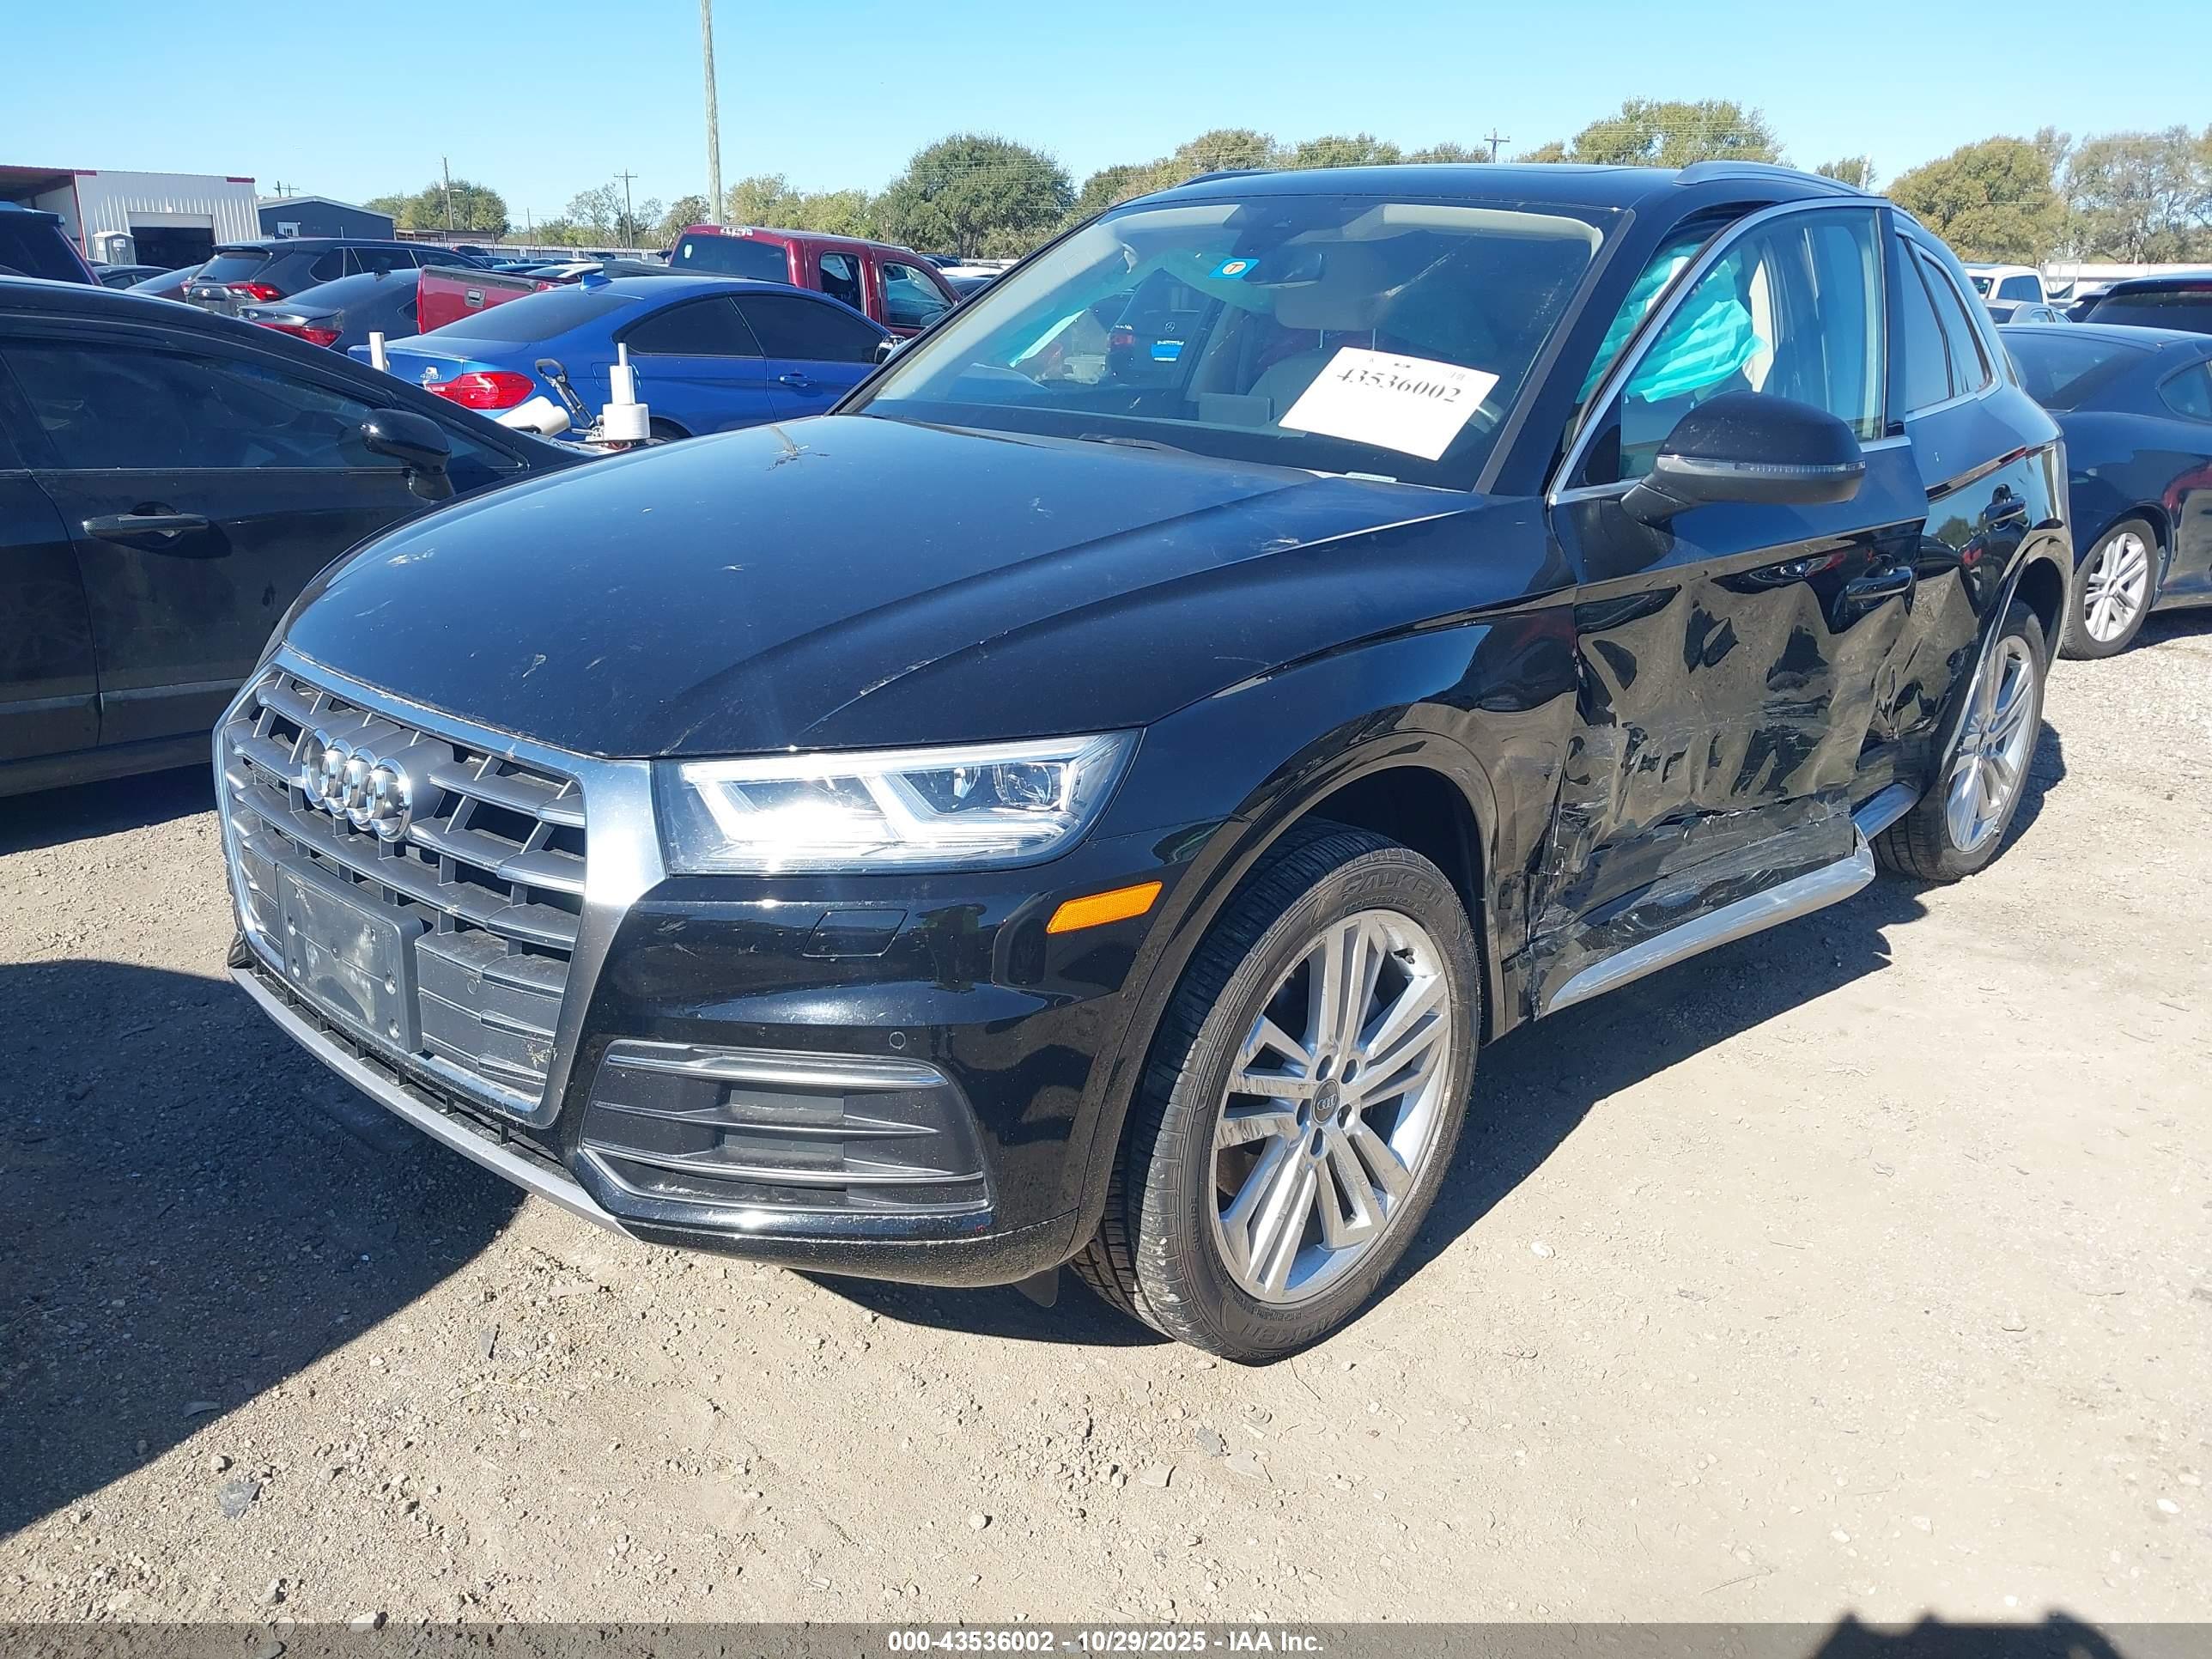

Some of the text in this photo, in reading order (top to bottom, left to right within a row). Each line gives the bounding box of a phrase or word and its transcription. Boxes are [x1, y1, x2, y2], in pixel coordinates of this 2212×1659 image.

[1336, 368, 1462, 403] 43536002
[1340, 872, 1444, 908] FALKEN
[1189, 1194, 1201, 1251] OUTSIDE
